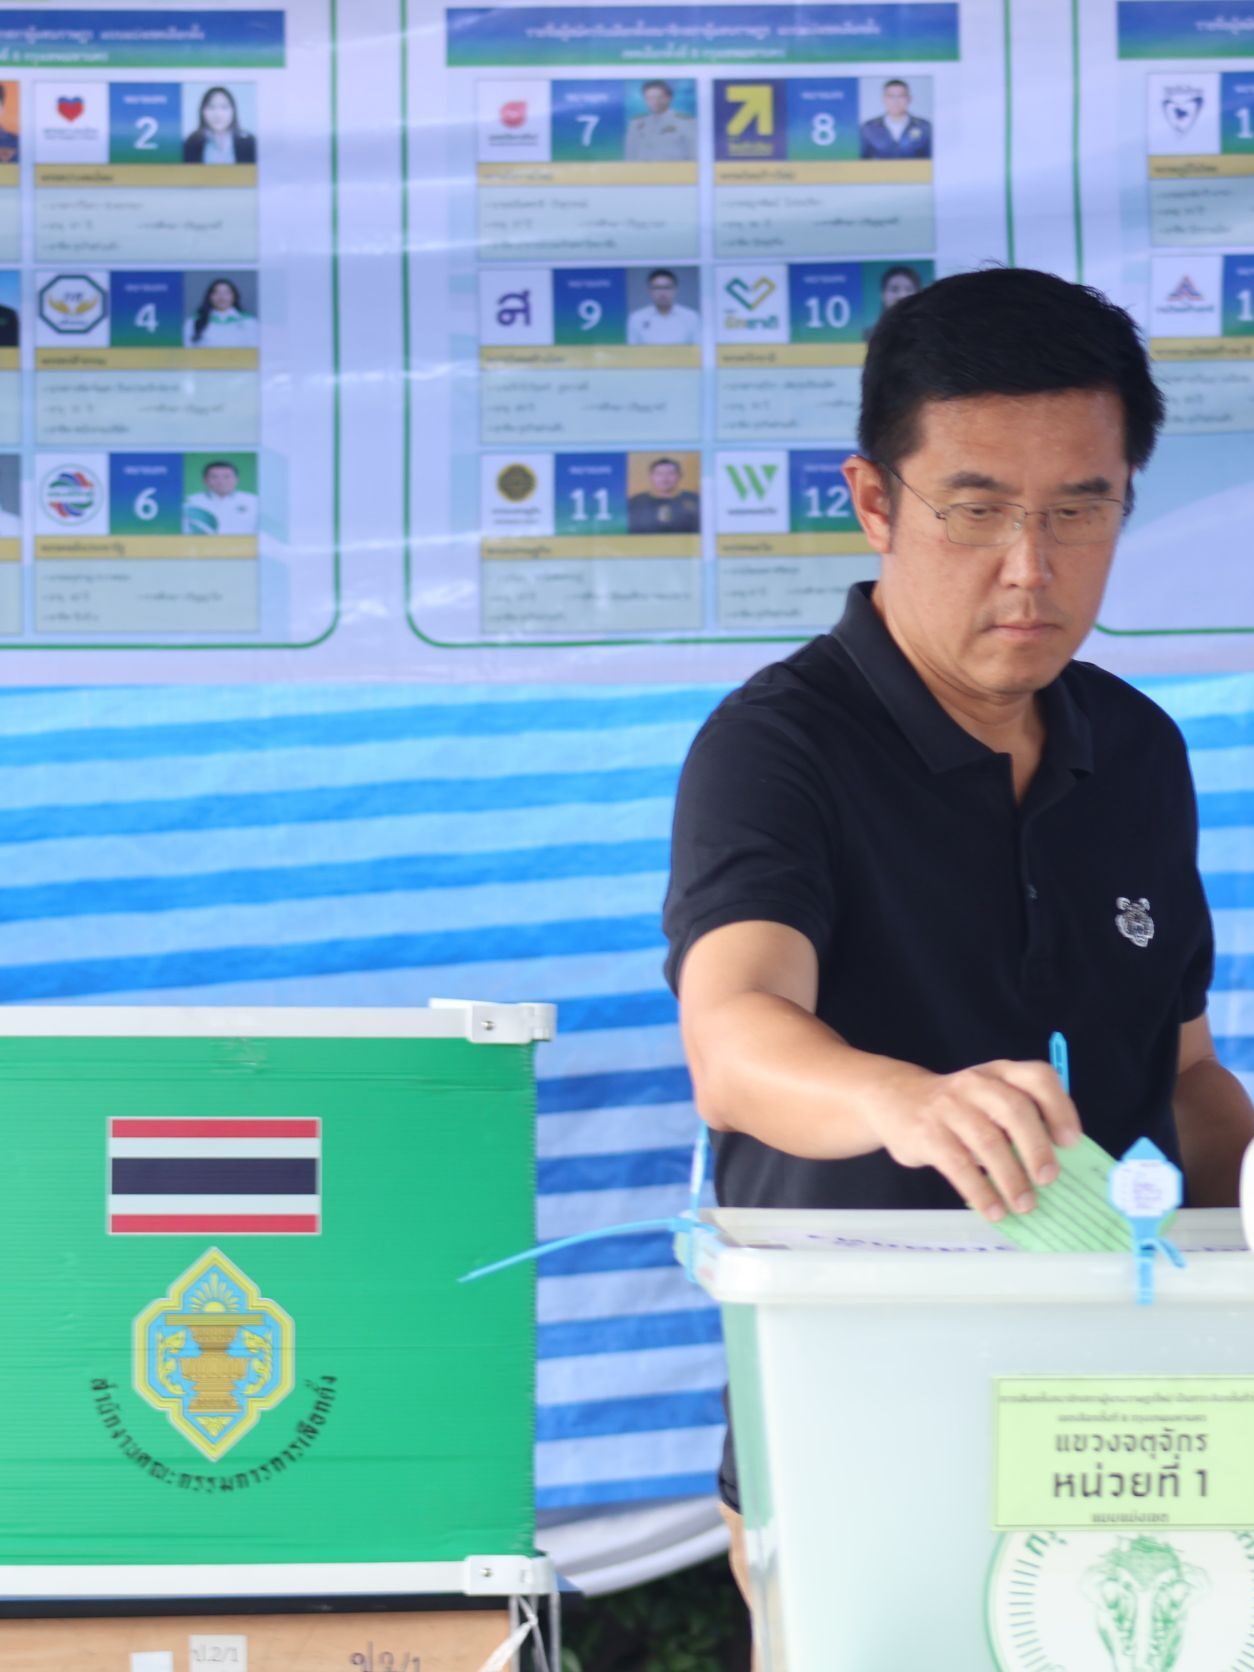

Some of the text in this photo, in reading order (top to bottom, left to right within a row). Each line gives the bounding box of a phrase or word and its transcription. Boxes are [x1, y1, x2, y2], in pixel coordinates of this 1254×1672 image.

[133, 116, 159, 150] 2
[576, 115, 600, 147] 7
[811, 113, 836, 146] 8
[133, 303, 160, 334] 4
[578, 299, 601, 330] 9
[806, 296, 850, 328] 10
[133, 487, 159, 520] 6
[570, 488, 612, 521] 11
[805, 486, 850, 519] 12
[1055, 1428, 1208, 1459] แขวงจตุจักร
[1053, 1454, 1209, 1498] หน่วยที่ 1
